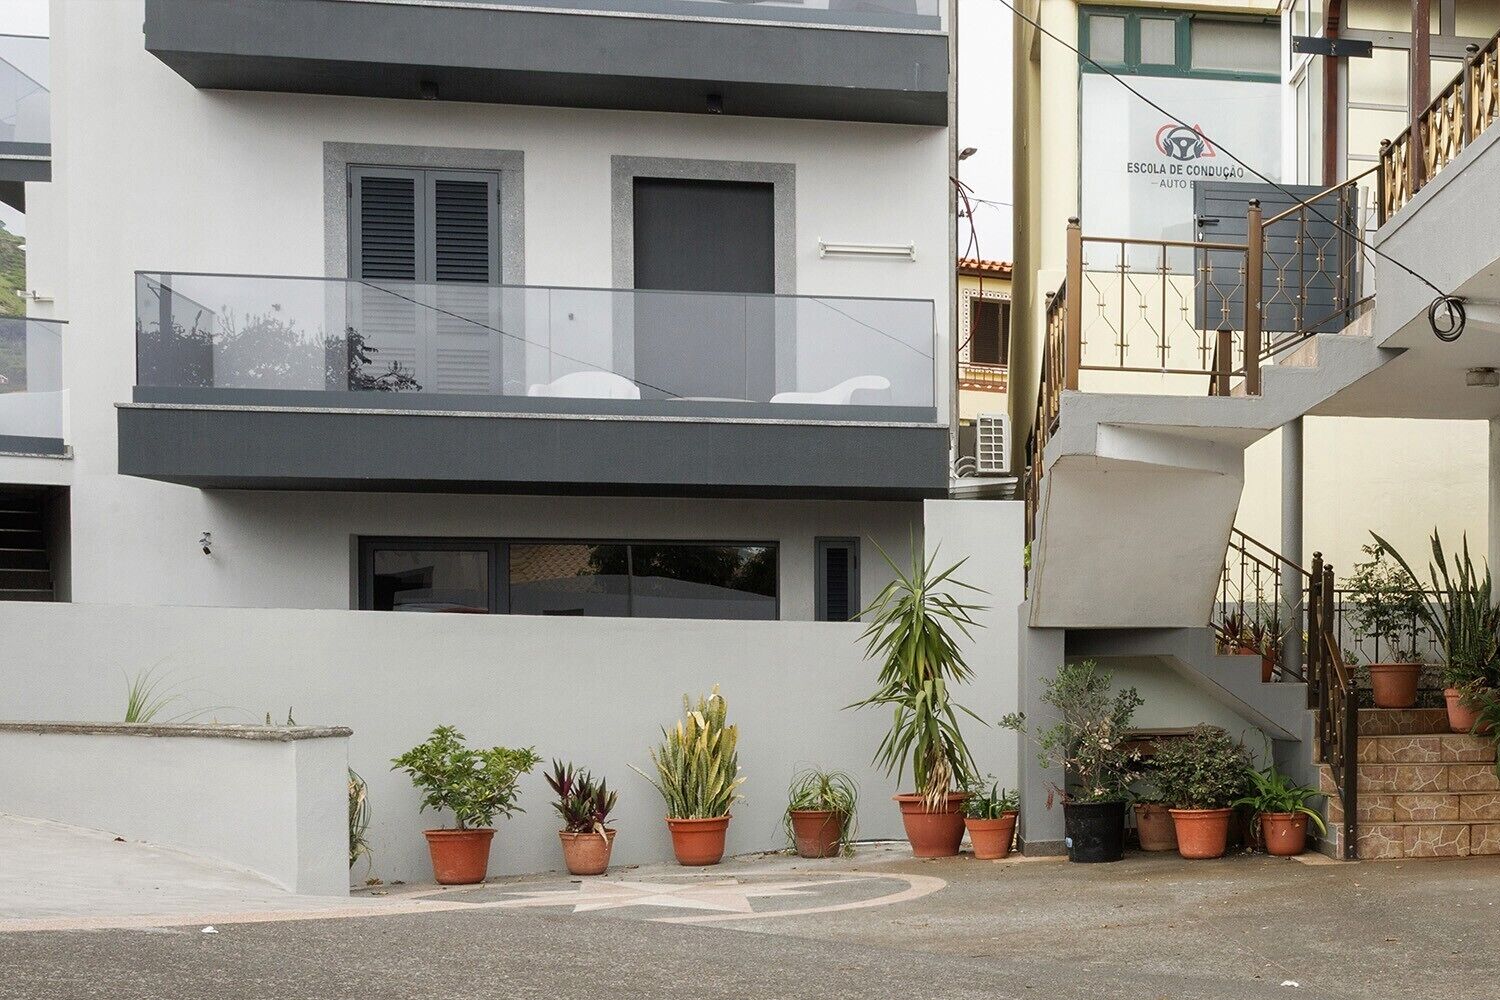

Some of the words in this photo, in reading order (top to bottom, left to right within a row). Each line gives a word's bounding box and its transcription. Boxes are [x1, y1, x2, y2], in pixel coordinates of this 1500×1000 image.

[1127, 162, 1166, 174] ESCOLA
[1169, 164, 1183, 175] DE
[1186, 165, 1244, 180] CONDUÇÃO
[1159, 179, 1187, 189] AUTO
